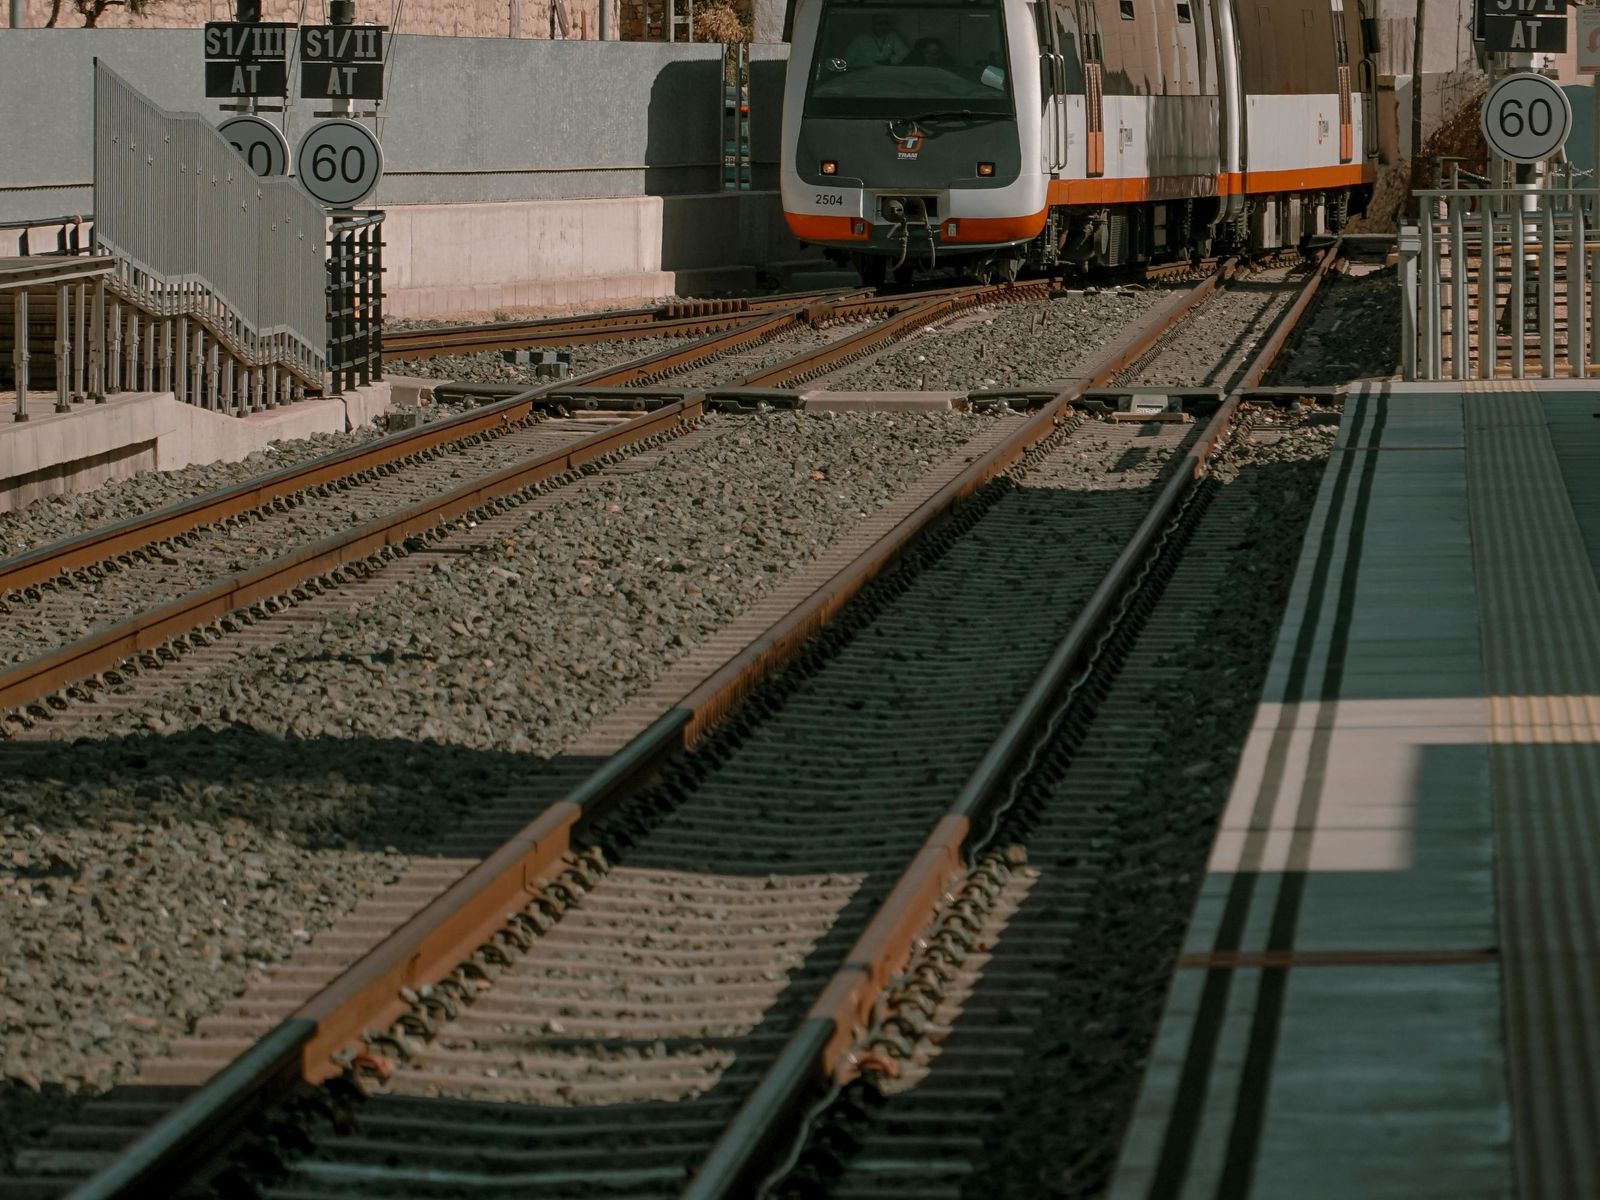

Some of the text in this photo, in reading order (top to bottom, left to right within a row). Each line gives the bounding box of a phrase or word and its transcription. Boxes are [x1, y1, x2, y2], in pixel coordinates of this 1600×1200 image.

[206, 27, 284, 56] S1/III
[306, 29, 377, 58] S1/II
[1510, 20, 1542, 49] AT
[231, 65, 261, 93] AT
[327, 67, 358, 95] AT
[1499, 98, 1553, 138] 60
[230, 141, 272, 176] 0
[312, 144, 365, 184] 60
[815, 194, 843, 206] 2504
